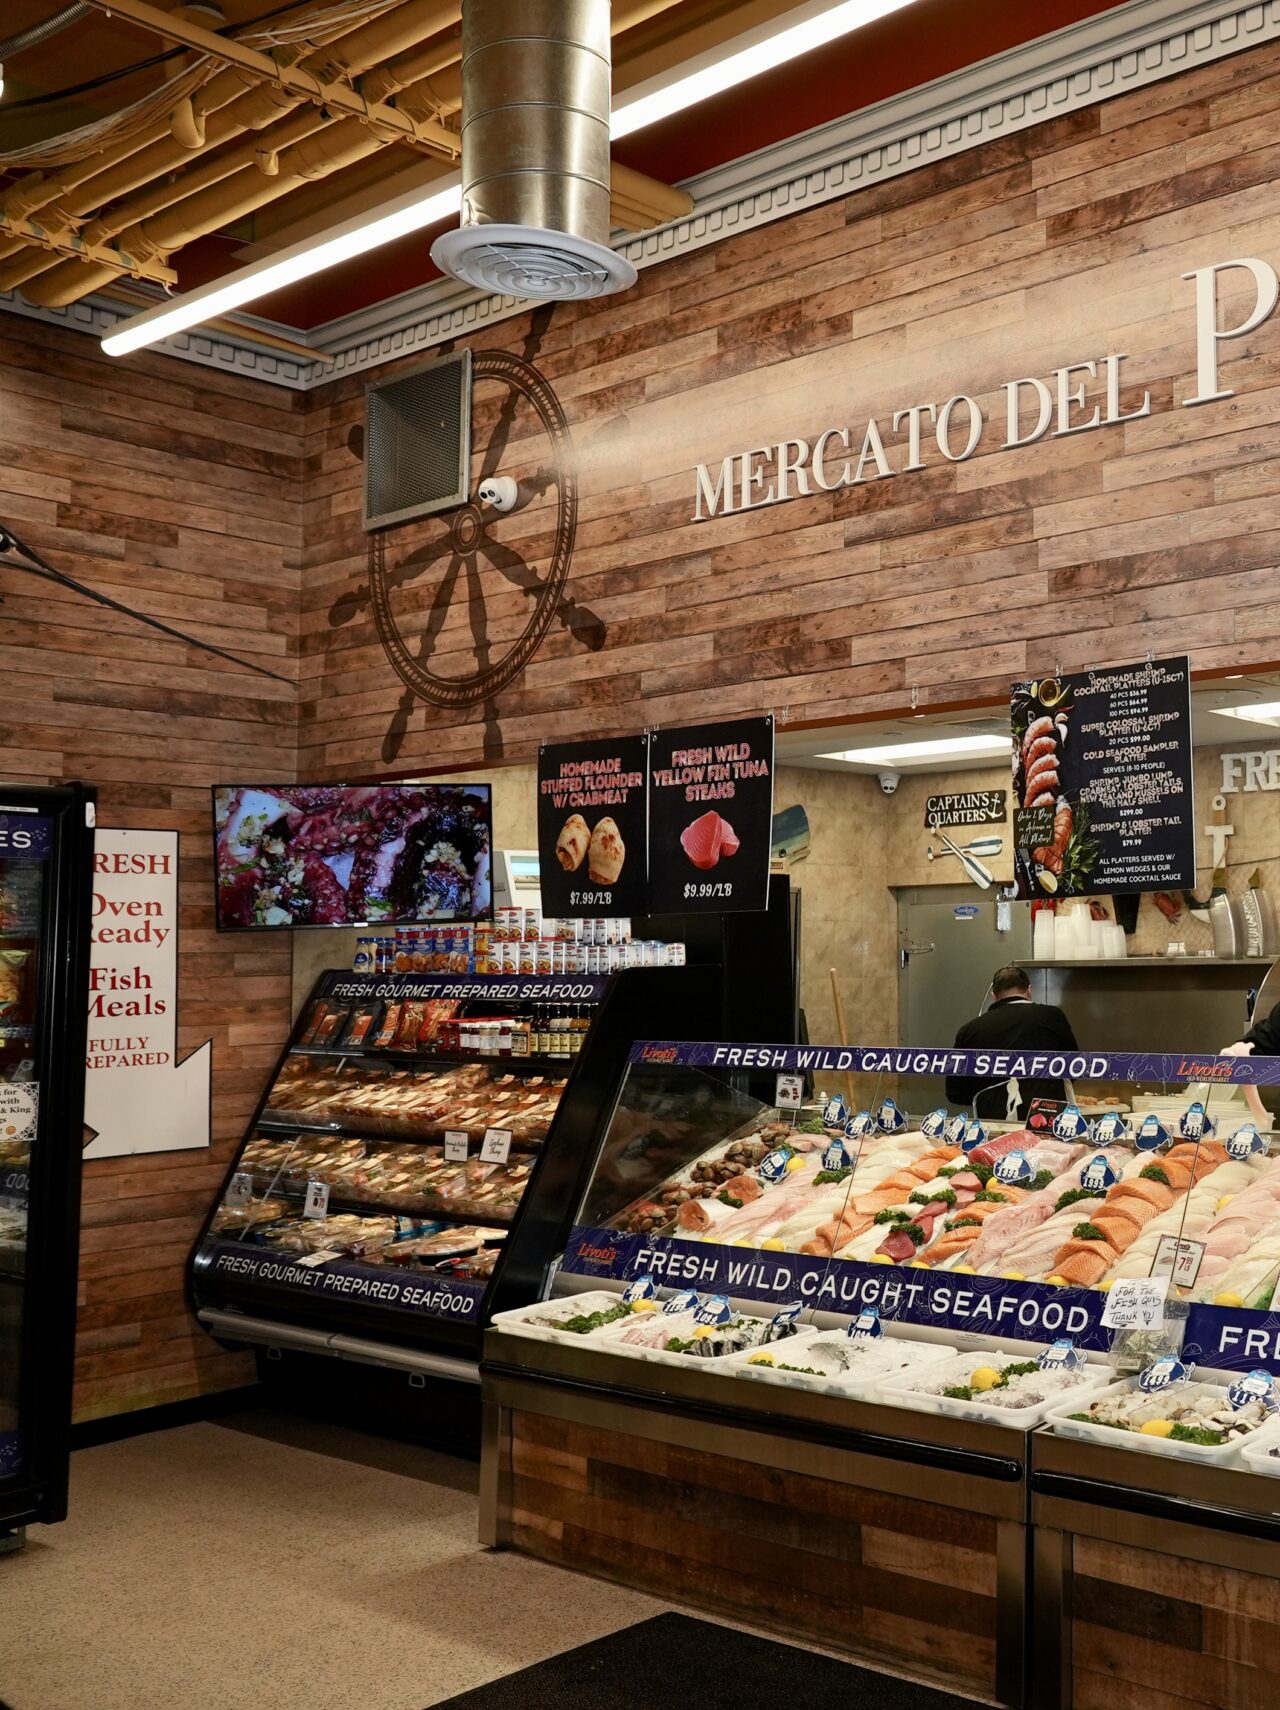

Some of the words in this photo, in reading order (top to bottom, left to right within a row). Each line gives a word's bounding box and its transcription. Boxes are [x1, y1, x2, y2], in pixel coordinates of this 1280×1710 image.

[690, 395, 983, 522] MERCATO
[1001, 354, 1151, 450] DEL
[1074, 683, 1112, 697] COCKTAIL
[1114, 678, 1151, 690] PLATTERS
[1081, 722, 1105, 733] SUPER
[1106, 717, 1148, 729] COLOSSAL
[1148, 711, 1180, 724] SHRIMP
[1099, 726, 1131, 737] PLATTER
[672, 748, 713, 768] FRESH
[715, 742, 751, 761] WILD
[1083, 750, 1105, 760] COLD
[1105, 745, 1142, 758] SEAFOOD
[1143, 741, 1179, 753] SAMPLER
[1114, 753, 1147, 764] PLATTER
[560, 758, 622, 778] HOMEMADE
[653, 766, 704, 787] YELLOW
[707, 763, 731, 781] FIN
[732, 759, 769, 778] TUNA
[1103, 766, 1125, 774] SERVES
[1140, 761, 1166, 770] PEOPLE)
[1122, 773, 1150, 783] JUMBO
[1151, 771, 1173, 780] LUMP
[540, 776, 581, 795] STUFFED
[585, 772, 643, 791] FLOUNDER
[685, 781, 736, 802] STEAKS
[1124, 780, 1158, 792] LOBSTER
[552, 794, 567, 809] W/
[569, 788, 629, 807] CRABMEAT
[927, 792, 990, 812] CAPTAIN'S
[1080, 795, 1097, 804] NEW
[1099, 791, 1134, 802] ZEALAND
[1135, 786, 1170, 797] MUSSELS
[1170, 785, 1184, 794] ON
[1102, 800, 1117, 809] THE
[1117, 797, 1137, 807] HALF
[1138, 795, 1161, 805] SHELL
[928, 808, 987, 825] QUARTERS
[1090, 822, 1121, 833] SHRIMP
[1128, 817, 1163, 828] LOBSTER
[1163, 816, 1182, 825] TAIL
[1119, 827, 1152, 837] PLATTER
[93, 854, 171, 875] RESH
[1111, 856, 1140, 864] PLATTERS
[1141, 854, 1165, 862] SERVED
[1094, 877, 1128, 885] HOMEMADE
[1129, 874, 1160, 883] COCKTAIL
[1161, 873, 1182, 881] SAUCE
[1104, 867, 1125, 875] LEMON
[1126, 865, 1150, 873] WEDGES
[570, 890, 612, 906] $7.99/LB
[683, 882, 733, 899] $9.99/LB
[92, 892, 163, 917] Oven
[91, 919, 171, 948] eady
[89, 966, 153, 992] Fish
[332, 984, 375, 998] FRESH
[375, 984, 441, 998] GOURMET
[444, 984, 519, 999] PREPARED
[519, 984, 594, 999] SEAFOOD
[88, 994, 166, 1019] Meals
[89, 1036, 149, 1054] FULLY
[85, 1052, 170, 1070] REPARED
[713, 1047, 788, 1068] FRESH
[797, 1050, 853, 1070] WILD
[861, 1052, 968, 1075] CAUGHT
[973, 1055, 1109, 1078] SEAFOOD
[216, 1254, 258, 1275] FRESH
[258, 1262, 323, 1287] GOURMET
[323, 1273, 400, 1301] PREPARED
[400, 1287, 474, 1315] SEAFOOD
[634, 1249, 719, 1281] FRESH
[728, 1261, 792, 1291] WILD
[800, 1271, 924, 1309] CAUGHT
[931, 1287, 1089, 1333] SEAFOOD
[1109, 1310, 1138, 1322] THANK
